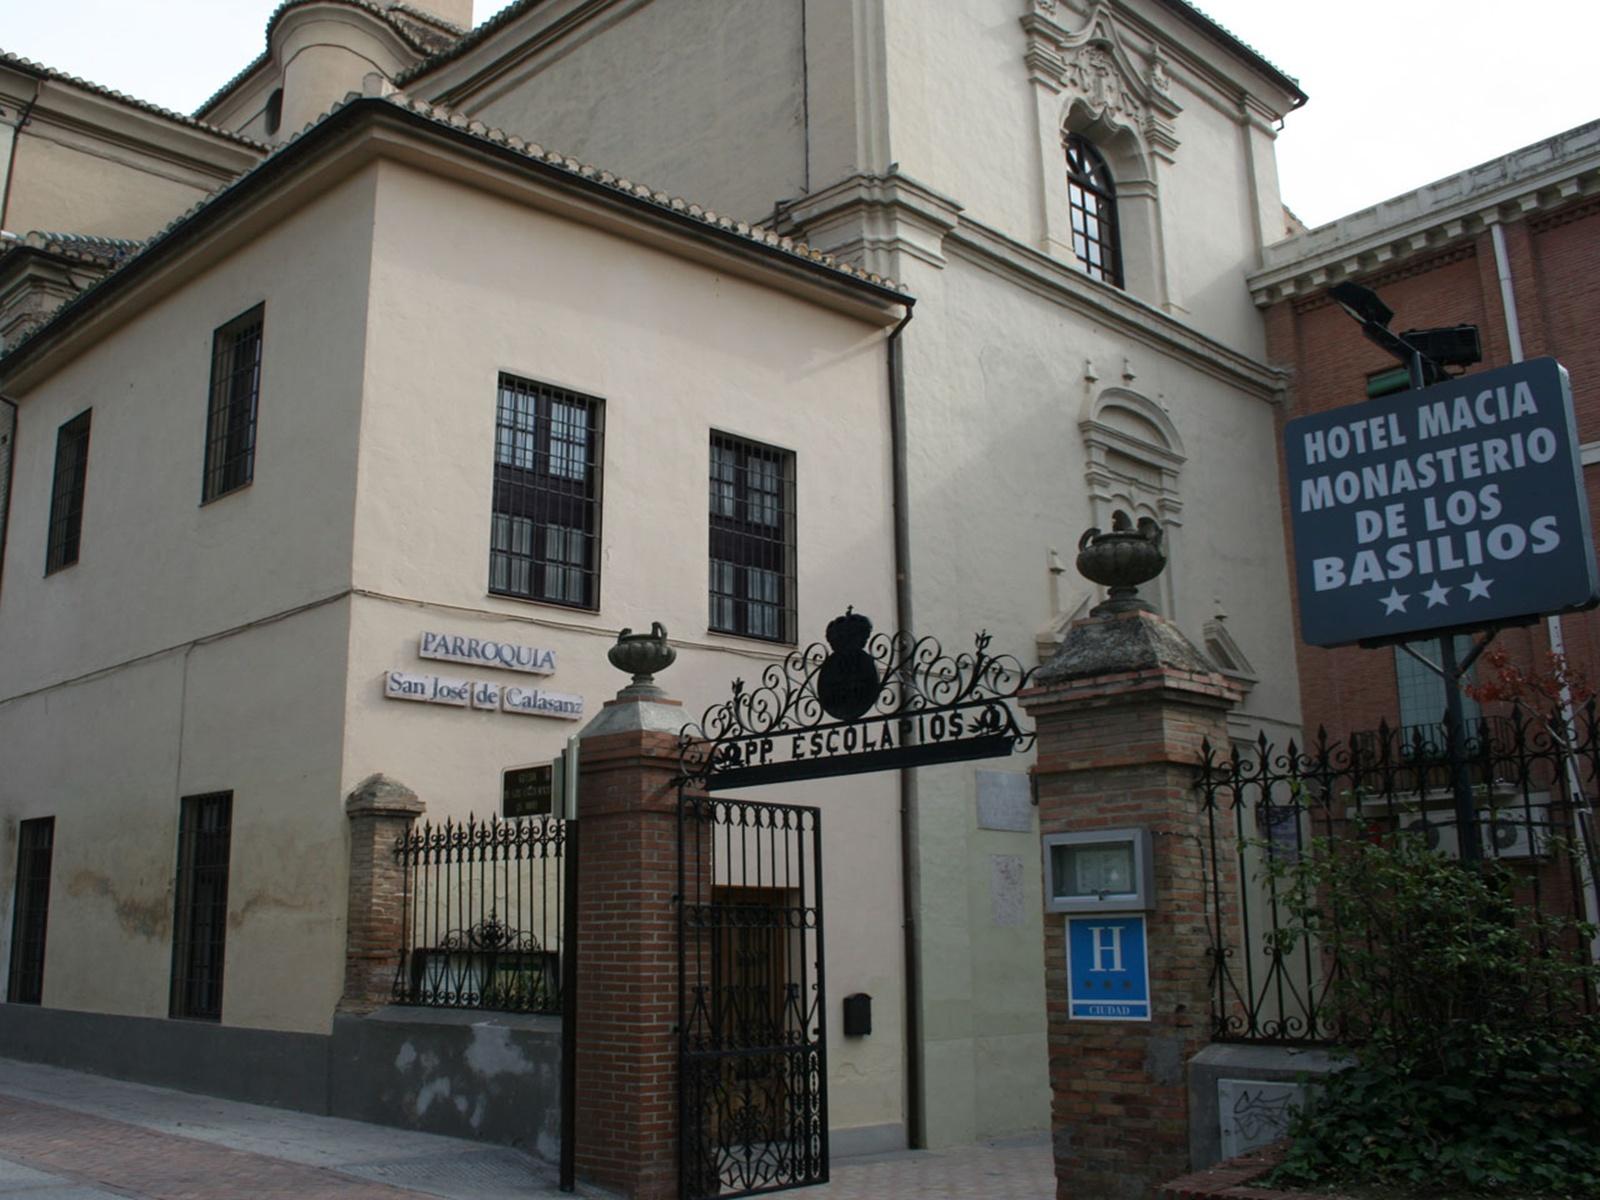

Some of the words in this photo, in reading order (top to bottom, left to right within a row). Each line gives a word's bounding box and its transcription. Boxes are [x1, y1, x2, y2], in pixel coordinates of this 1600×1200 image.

[1304, 413, 1407, 466] HOTEL
[1418, 381, 1539, 440] MACIA
[1300, 427, 1557, 513] MONASTERIO
[1355, 503, 1407, 545] DE
[1424, 483, 1502, 532] LOS
[1312, 515, 1561, 592] BASILIOS
[422, 631, 556, 669] PARROQUIA
[389, 671, 426, 695] San
[431, 677, 468, 700] José
[475, 683, 498, 704] de
[506, 687, 583, 714] Calasanz
[792, 711, 964, 759] ESCOLAPIOS
[1088, 926, 1126, 972] H
[1089, 1005, 1130, 1016] CIUDAD
